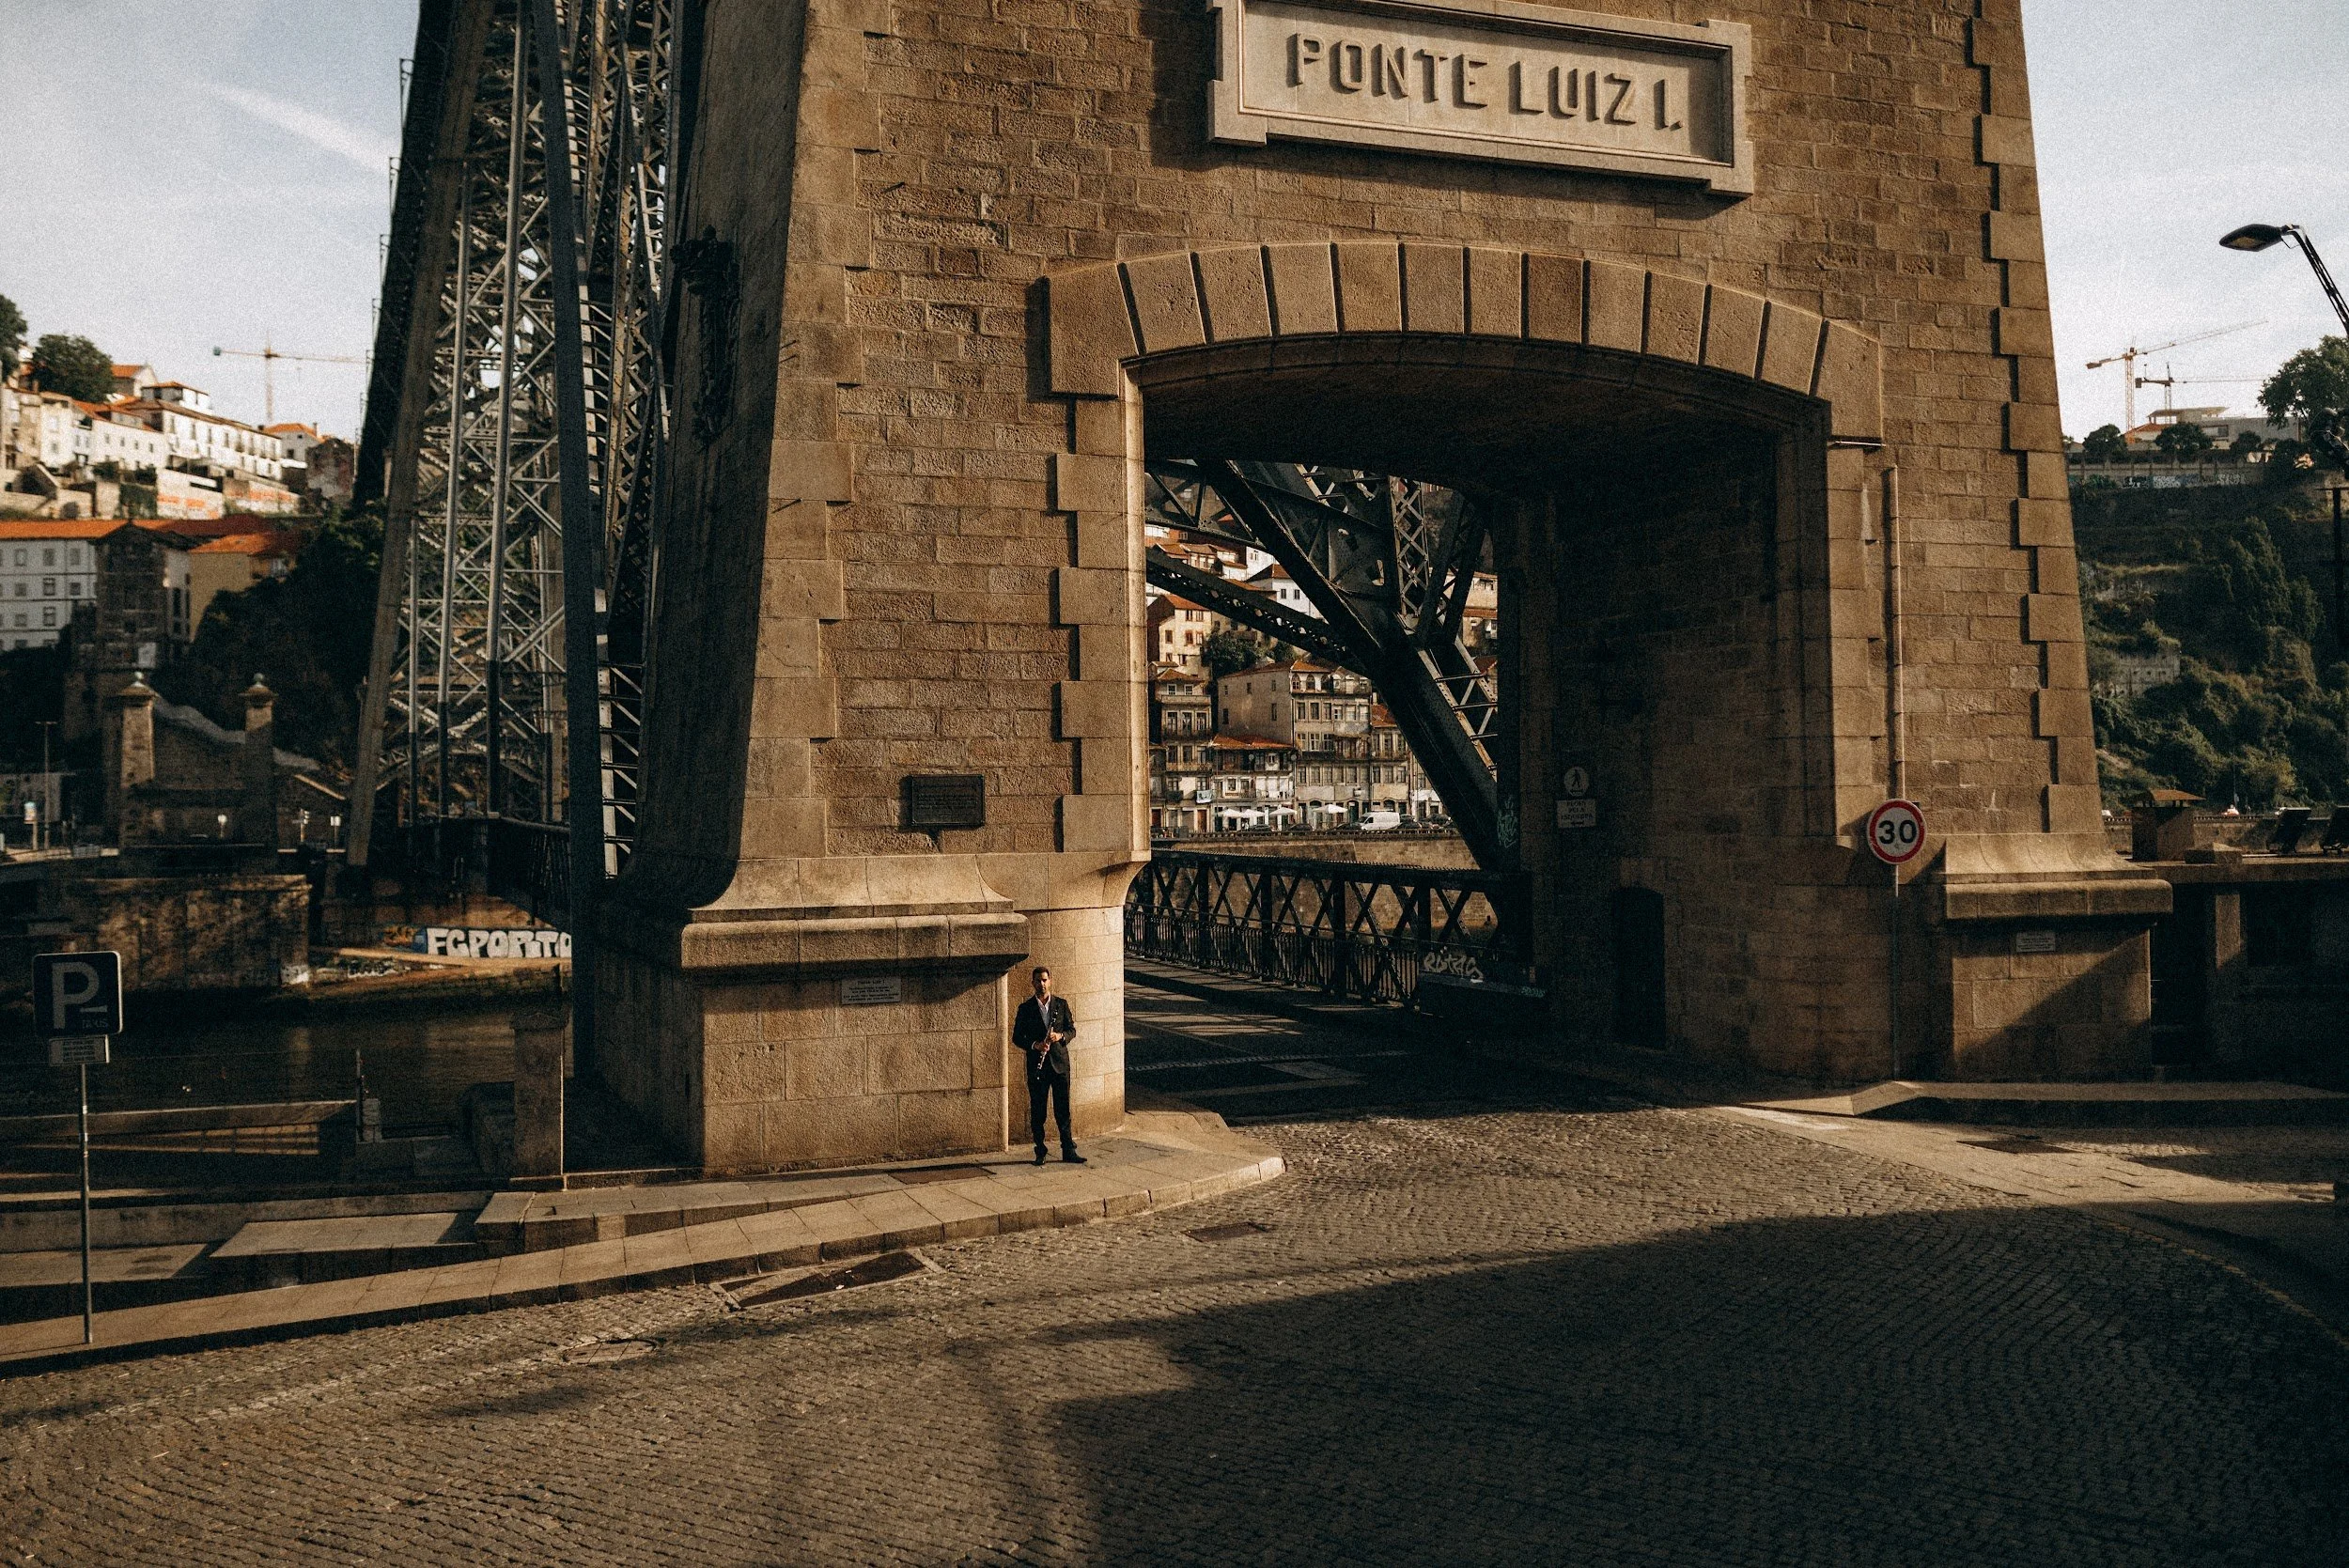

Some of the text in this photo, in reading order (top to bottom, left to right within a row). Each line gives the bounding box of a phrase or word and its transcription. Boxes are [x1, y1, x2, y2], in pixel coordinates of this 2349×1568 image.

[1287, 33, 1490, 109] PONTE
[1508, 60, 1638, 126] LUIZ
[1878, 819, 1918, 845] 30
[52, 961, 101, 1030] P
